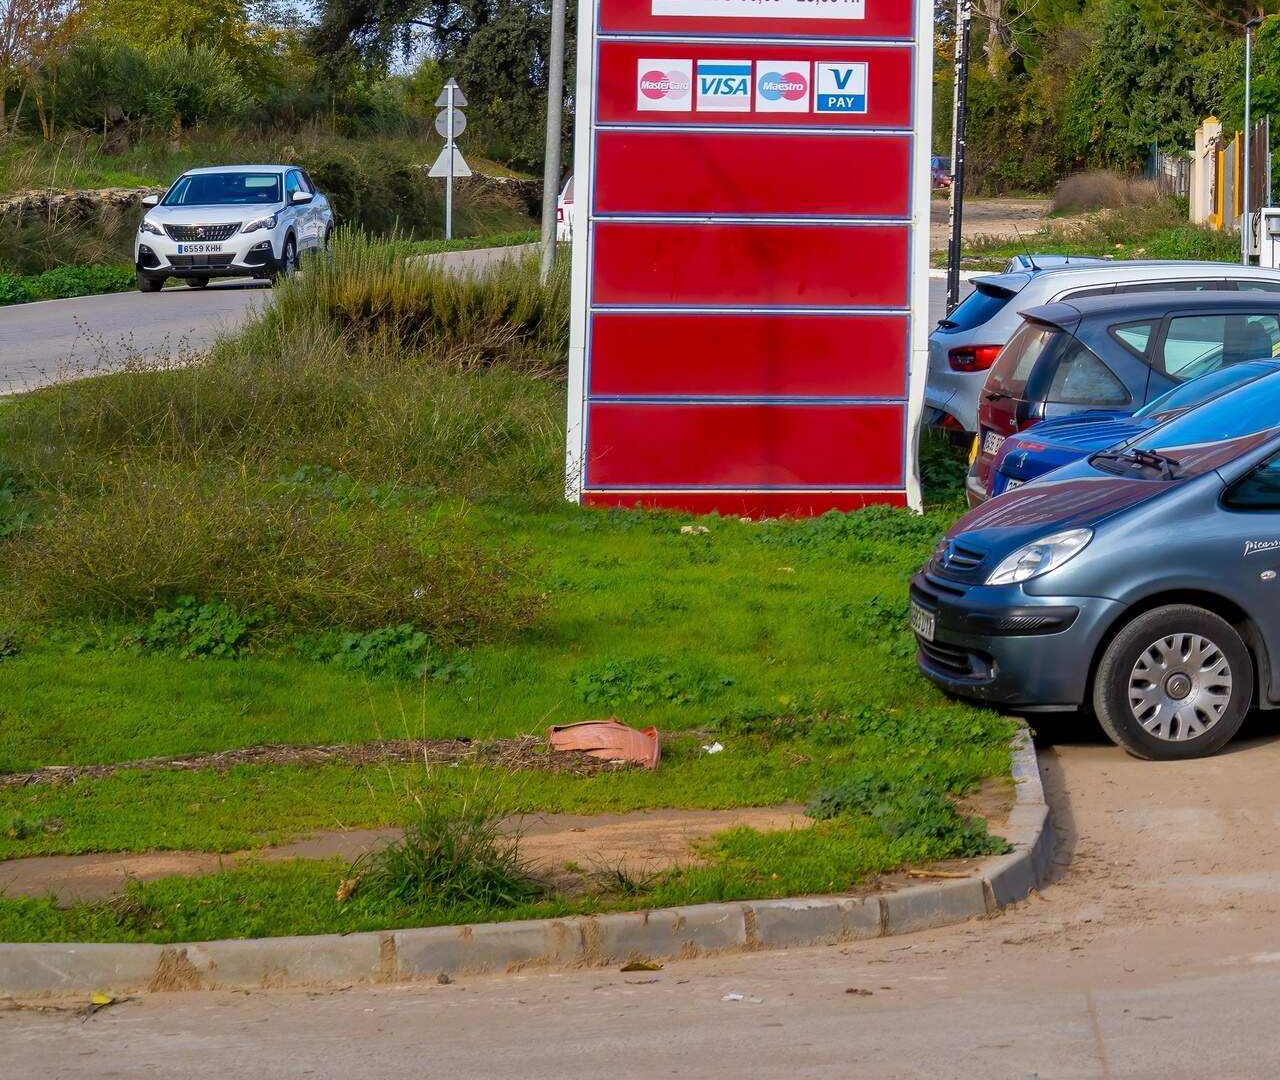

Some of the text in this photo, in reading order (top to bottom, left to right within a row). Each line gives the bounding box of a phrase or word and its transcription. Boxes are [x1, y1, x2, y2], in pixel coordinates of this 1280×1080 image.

[827, 68, 854, 90] V
[640, 80, 689, 91] MasterCard
[699, 76, 748, 96] VISA
[762, 80, 804, 91] Maestro
[827, 96, 855, 108] PAY
[184, 244, 221, 253] 6559 KHH
